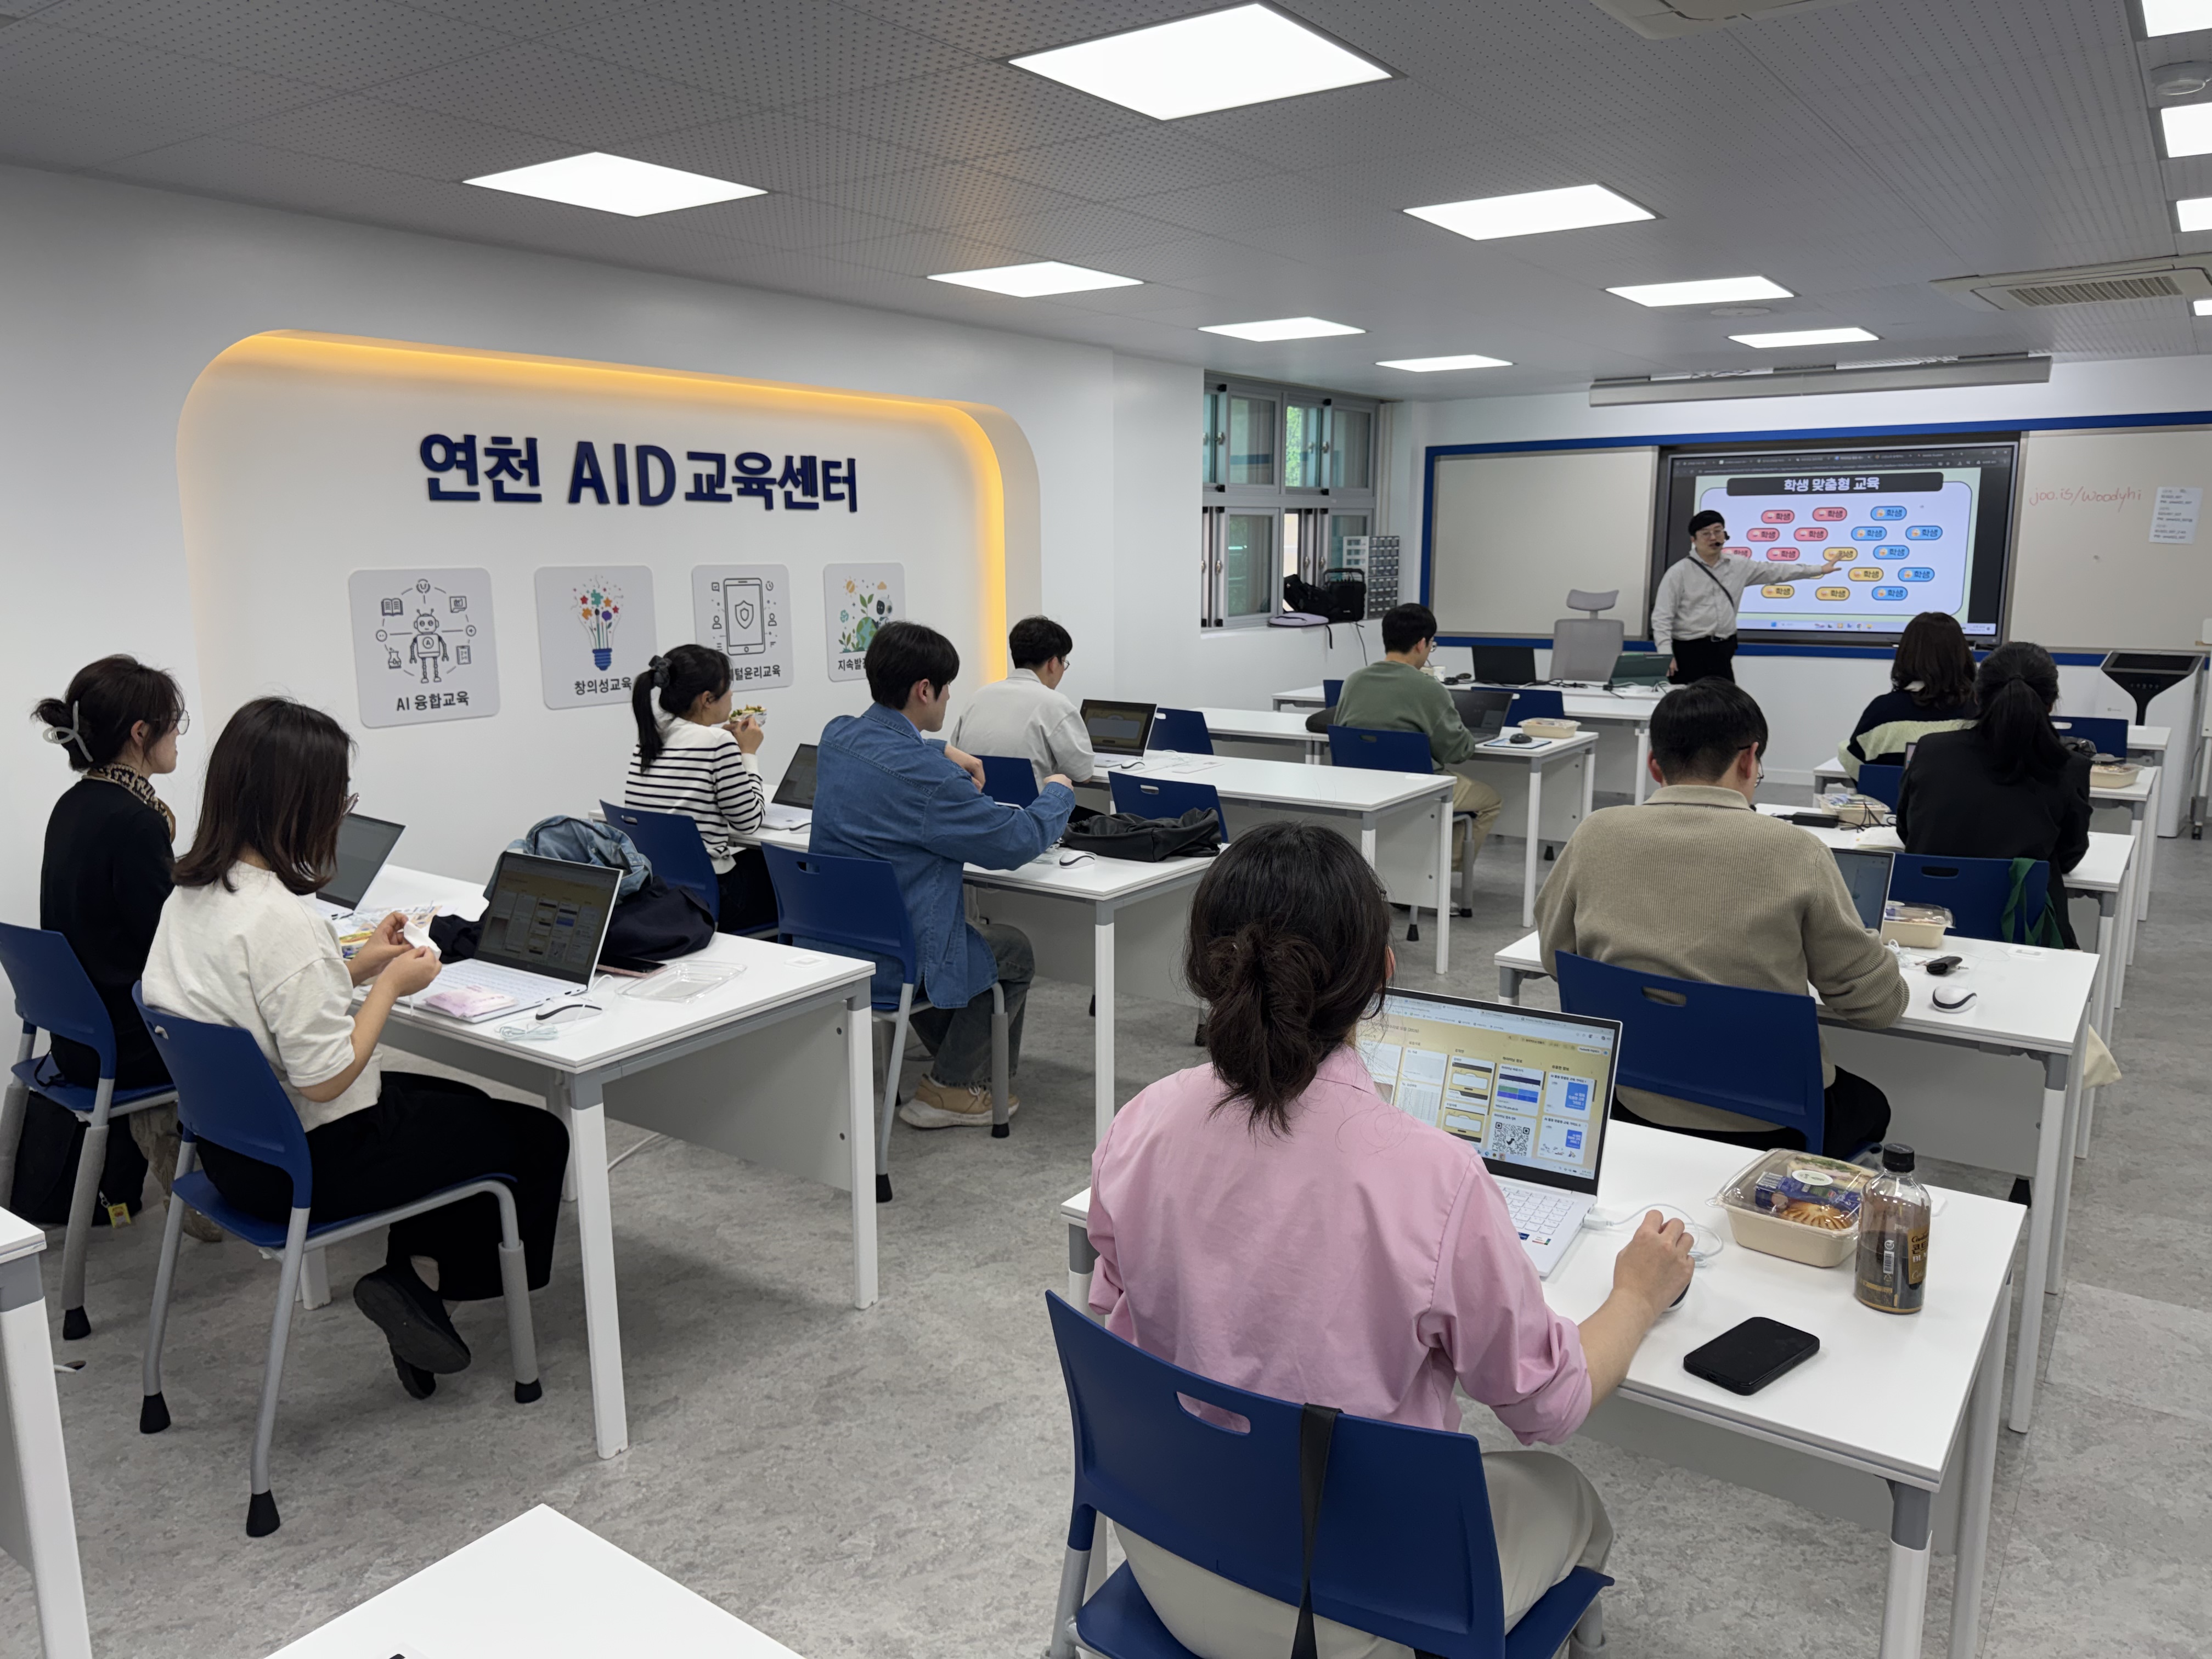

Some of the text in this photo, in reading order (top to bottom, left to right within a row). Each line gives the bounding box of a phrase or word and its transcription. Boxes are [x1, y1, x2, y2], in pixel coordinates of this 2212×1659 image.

[420, 433, 543, 503] 연천
[1784, 476, 1880, 492] 학생 맞춤형 교육
[1775, 512, 1791, 521] 학생
[1827, 510, 1843, 518] 학생
[1886, 509, 1903, 517] 학생
[1760, 531, 1776, 539] 학생
[1809, 530, 1825, 539] 학생
[1867, 529, 1883, 538] 학생
[1922, 528, 1938, 537] 학생
[1781, 550, 1796, 558] 학생
[1889, 548, 1905, 556] 학생
[1863, 571, 1880, 579] 학생
[1914, 570, 1931, 579] 학생
[1775, 588, 1791, 596] 학생
[1830, 590, 1846, 598] 학생
[1888, 589, 1904, 597] 학생
[730, 664, 781, 682] 털윤리교육
[574, 676, 633, 696] 창의성교육
[396, 691, 470, 712] AI 융합교육
